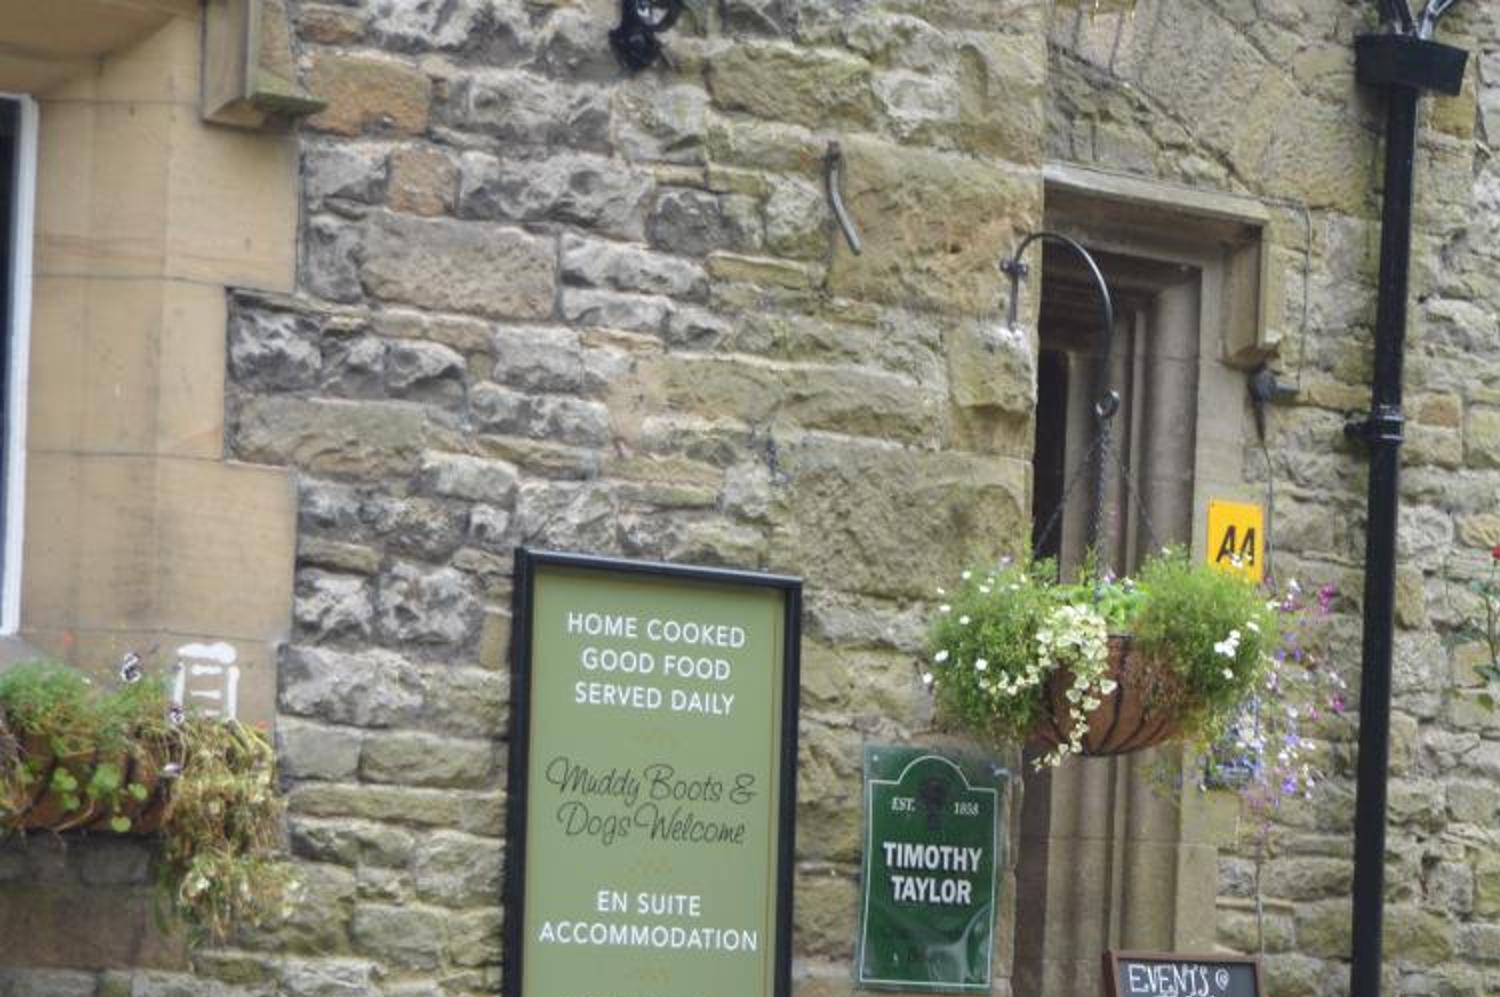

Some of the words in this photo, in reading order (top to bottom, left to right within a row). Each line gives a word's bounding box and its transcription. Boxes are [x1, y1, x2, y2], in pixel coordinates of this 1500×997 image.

[1215, 524, 1255, 566] AA
[567, 611, 638, 638] HOME
[647, 619, 746, 648] COOKED
[582, 647, 654, 674] GOOD
[664, 655, 731, 680] FOOD
[575, 681, 662, 709] SERVED
[671, 690, 735, 715] DAILY
[545, 756, 641, 806] Muddy
[643, 763, 723, 801] Boots
[729, 773, 757, 804] &
[556, 801, 632, 846] Dogs
[633, 803, 745, 844] Welcome
[883, 841, 983, 872] TIMOTHY
[597, 891, 628, 913] EN
[637, 893, 702, 917] SUITE
[891, 876, 972, 904] TAYLOR
[539, 921, 758, 951] ACCOMMODATION
[1128, 964, 1209, 997] EVENTS
